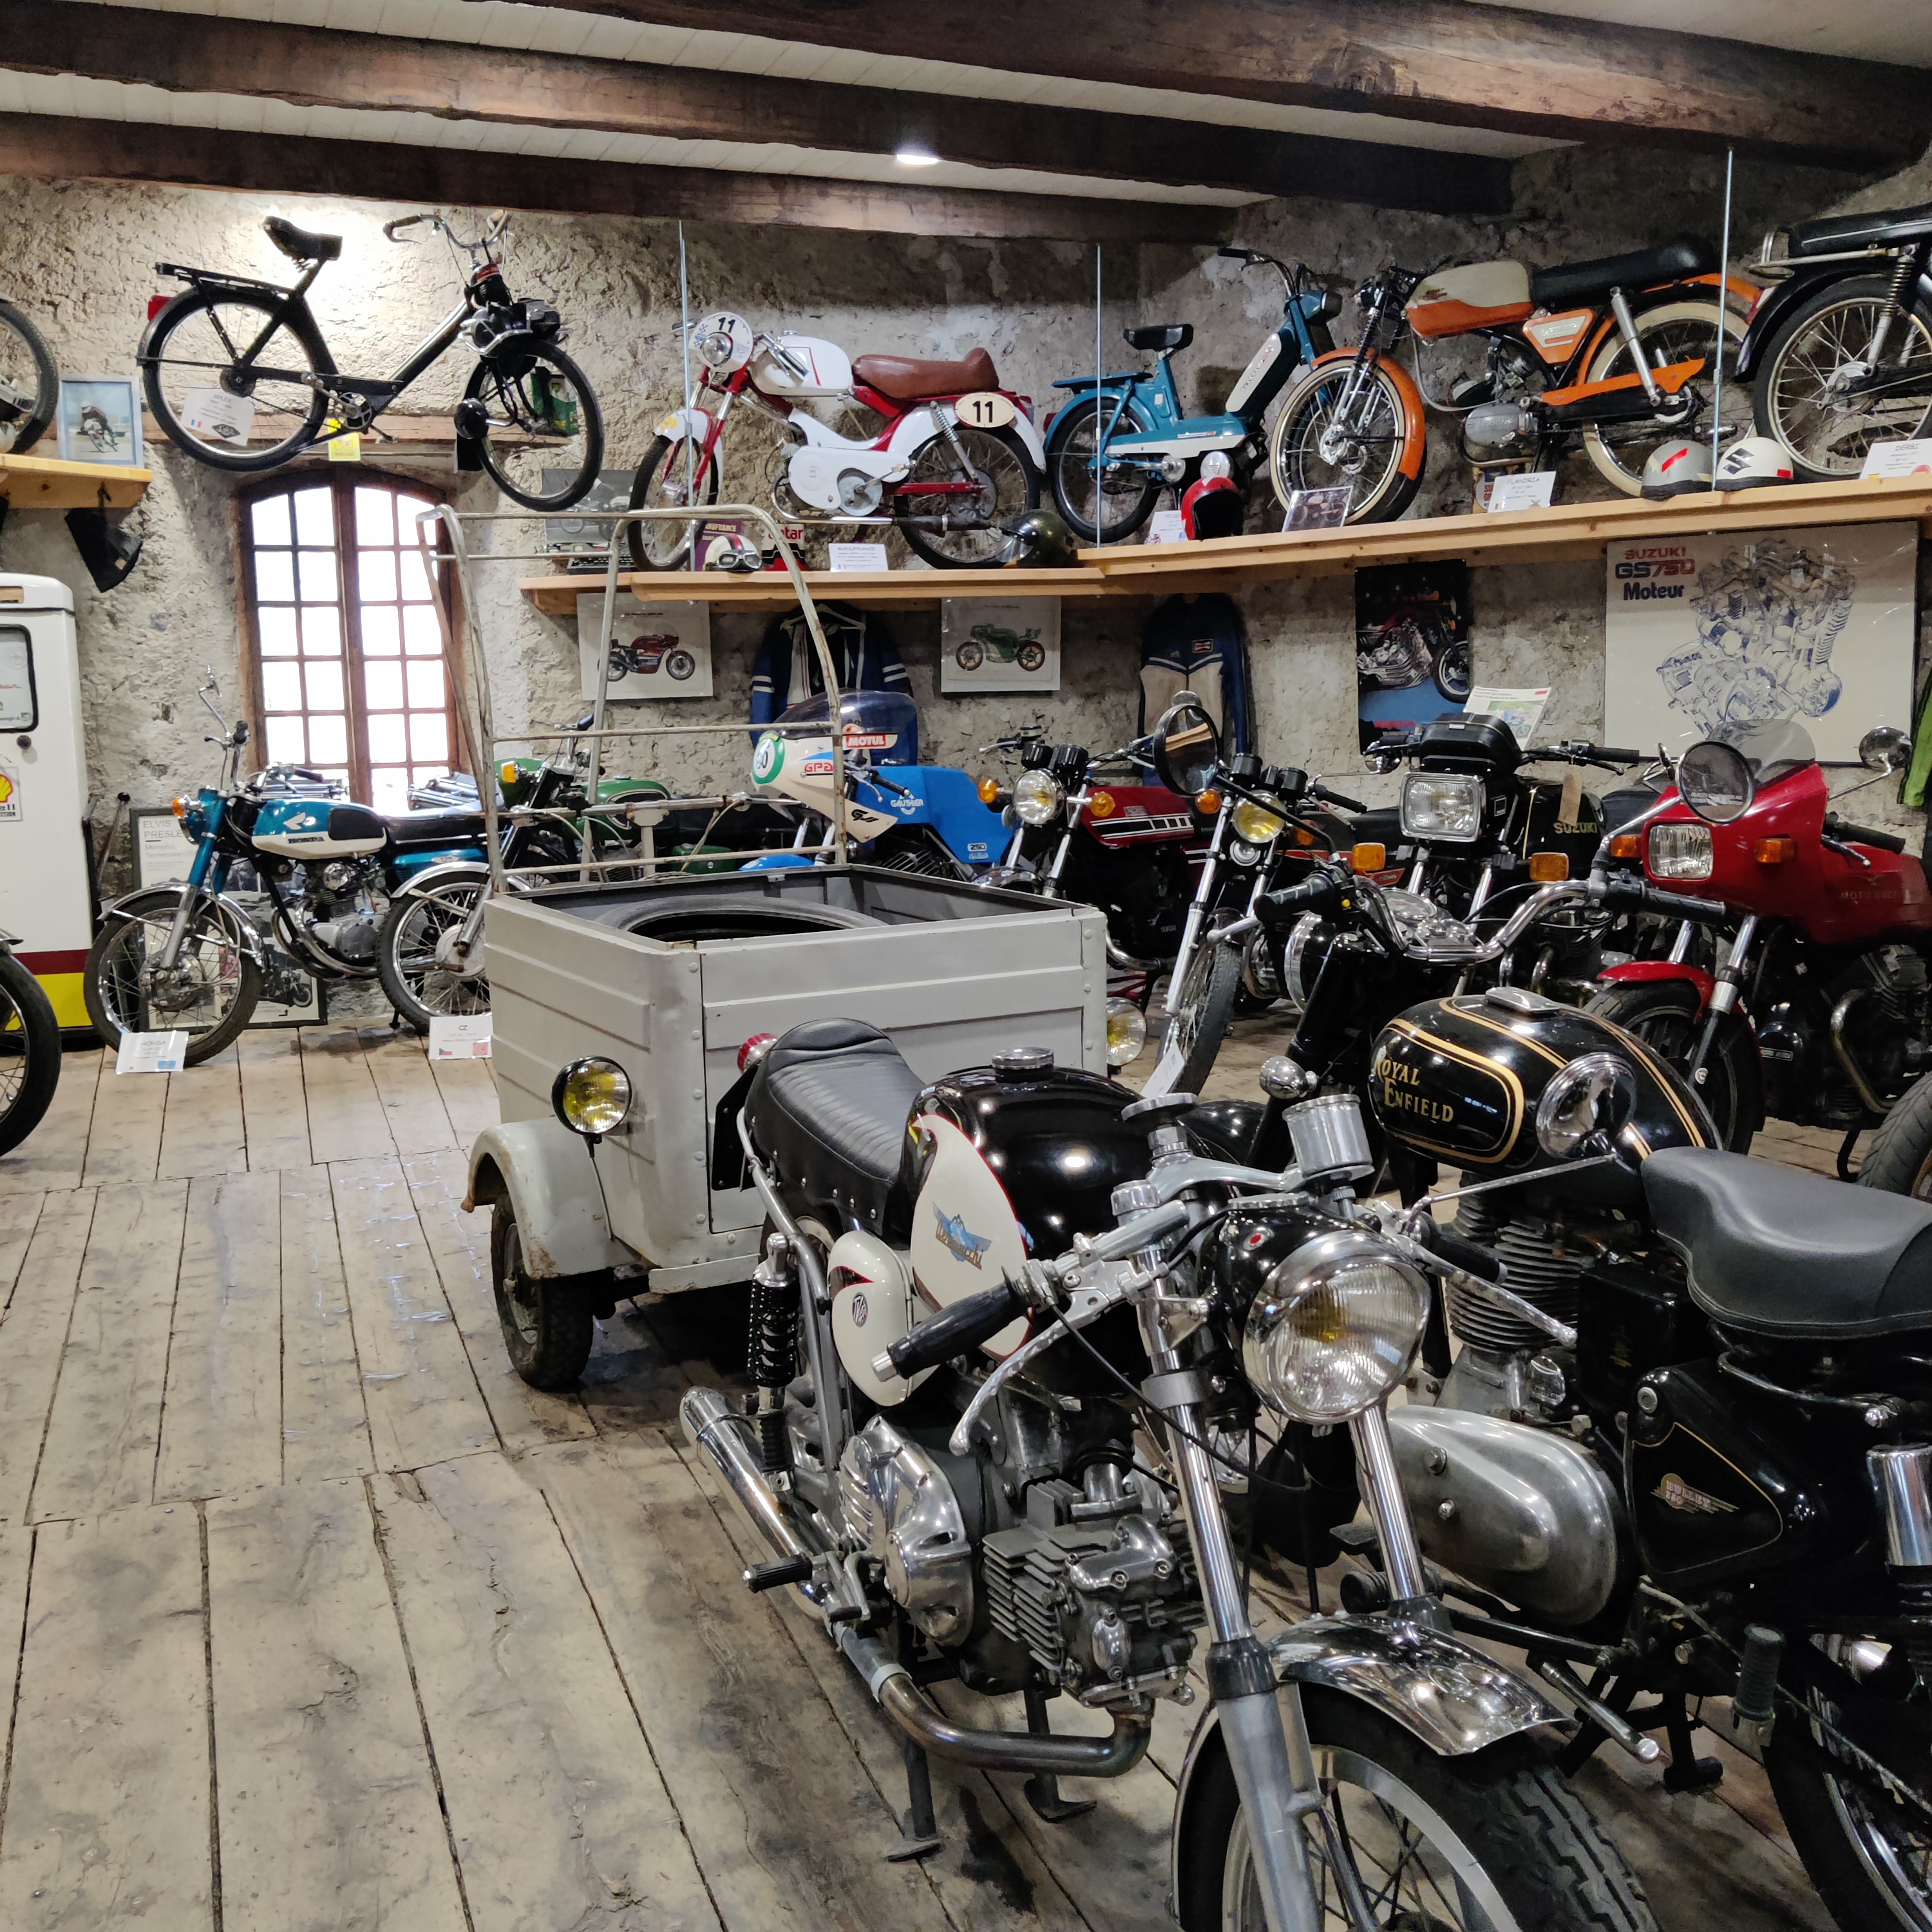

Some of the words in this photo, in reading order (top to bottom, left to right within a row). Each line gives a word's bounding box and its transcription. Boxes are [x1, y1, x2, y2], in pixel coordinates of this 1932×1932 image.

[718, 317, 735, 334] 11
[972, 401, 993, 423] 11
[1624, 546, 1687, 560] SUZUKI
[1615, 558, 1696, 579] GS750
[1623, 582, 1685, 601] Moteur
[848, 736, 884, 746] MOTUL
[143, 820, 171, 828] ELVIS
[1553, 822, 1597, 833] SUZUKI
[144, 830, 183, 838] PRESLE
[1667, 1481, 1710, 1508] BULLET
